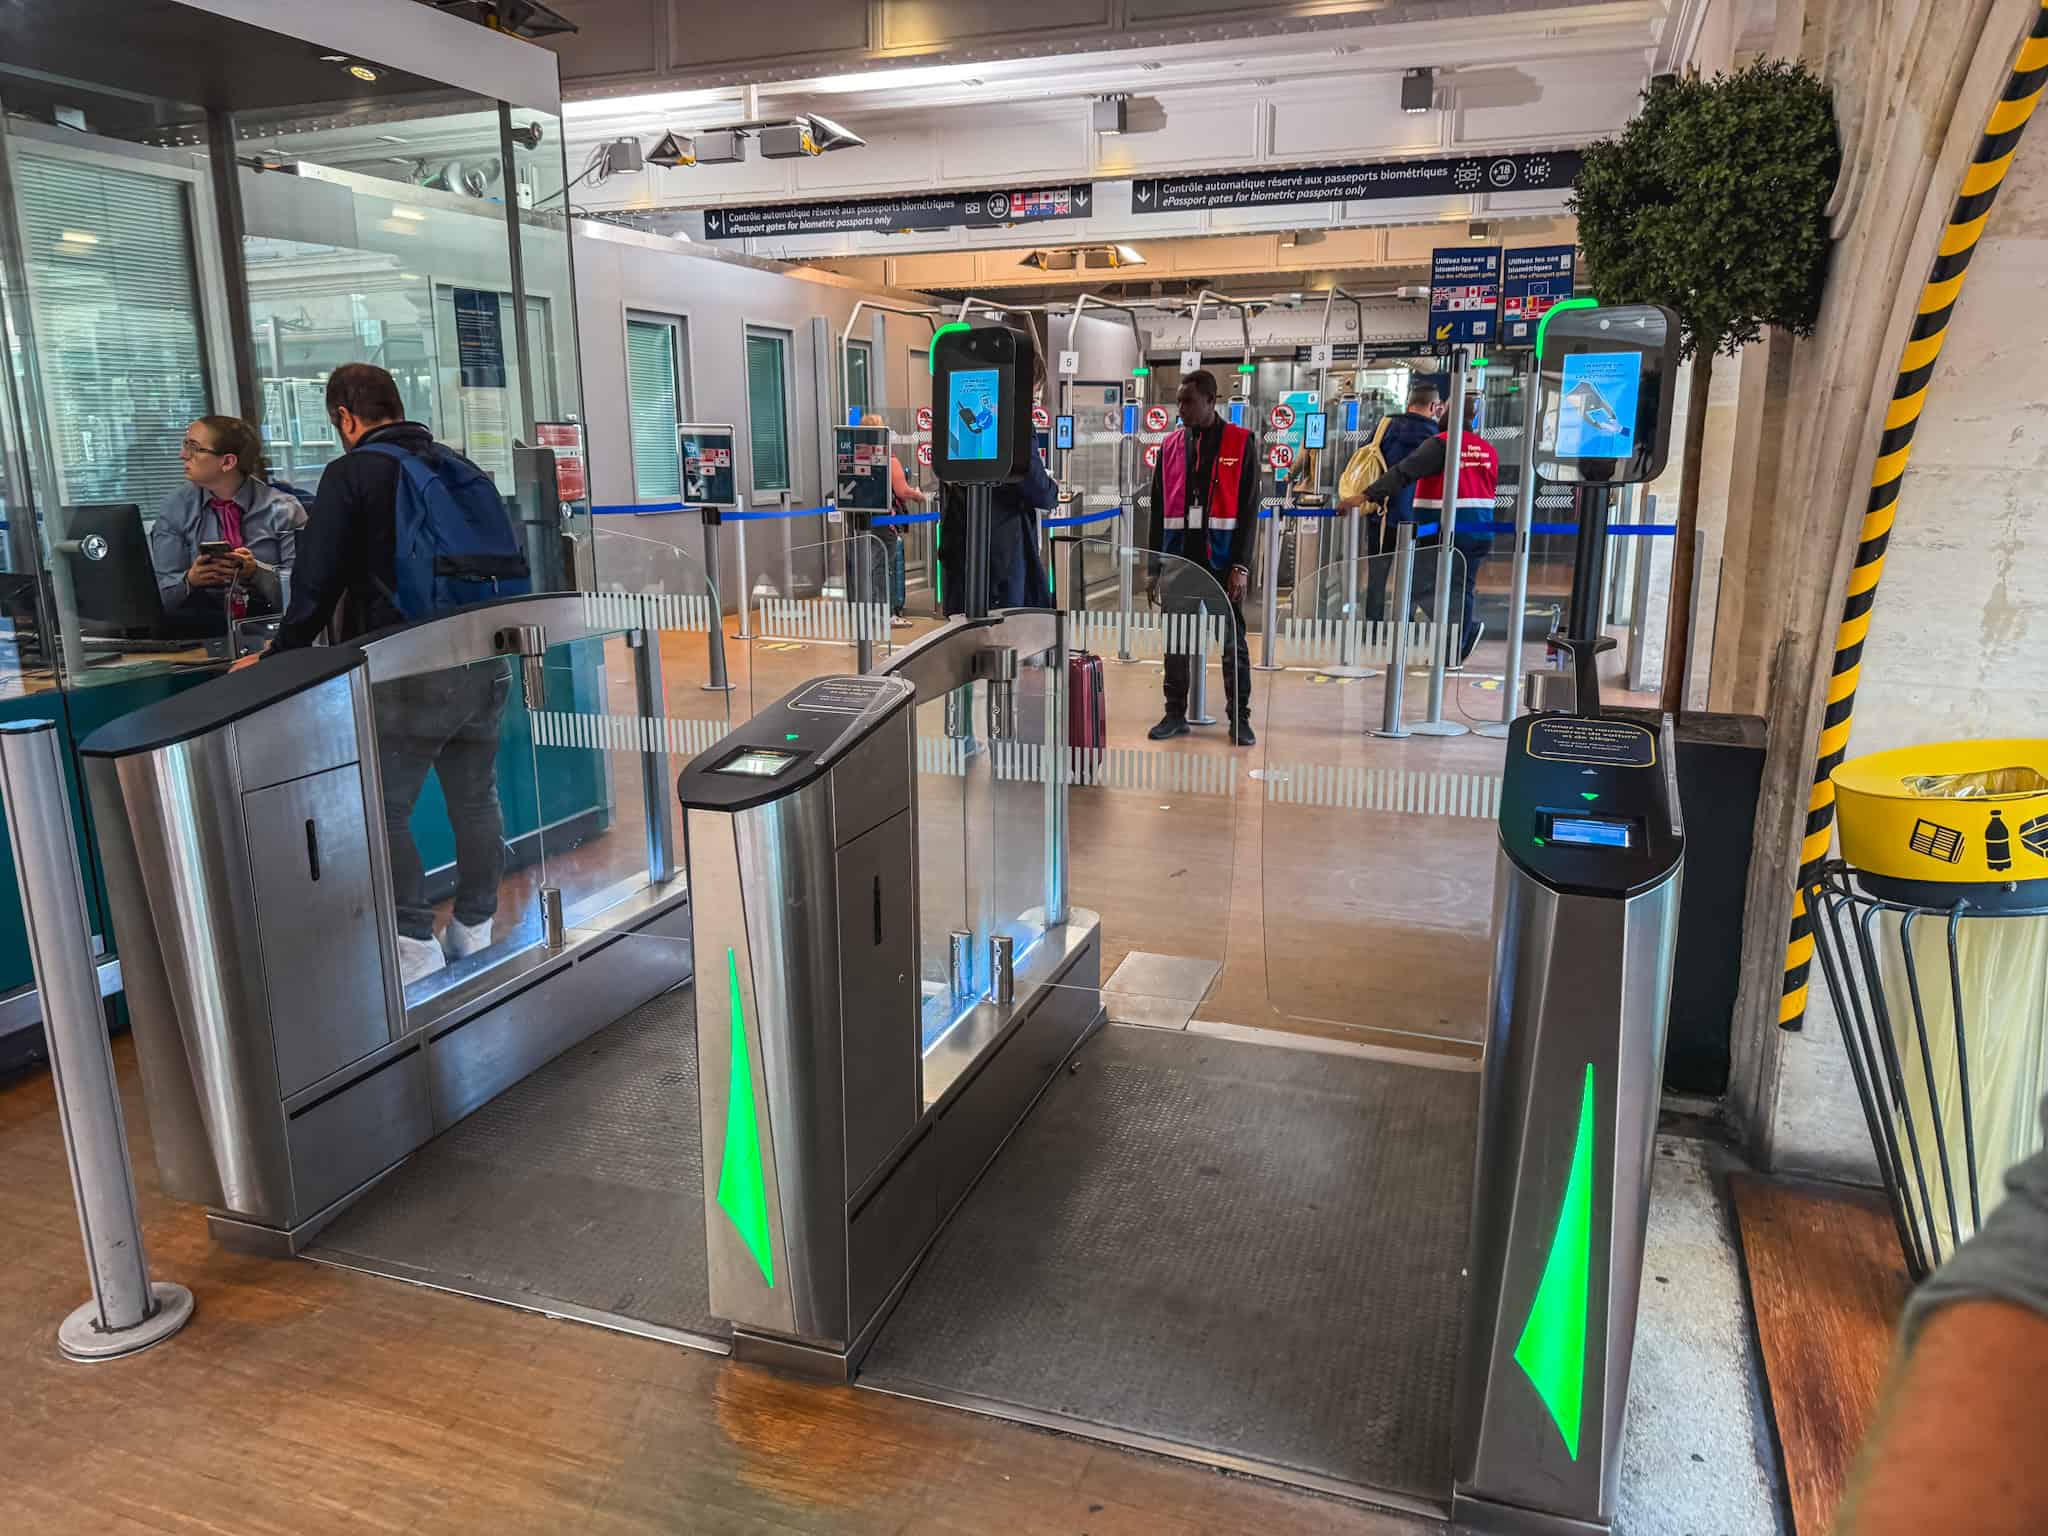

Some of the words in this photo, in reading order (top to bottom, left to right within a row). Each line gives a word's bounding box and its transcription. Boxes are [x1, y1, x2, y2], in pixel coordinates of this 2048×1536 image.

[1529, 165, 1545, 176] UE
[1163, 182, 1204, 194] Contrôle
[1205, 179, 1265, 191] automatique
[1268, 175, 1302, 187] réservé
[1305, 175, 1321, 185] aux
[1324, 172, 1378, 185] passeports
[1381, 167, 1448, 180] biométriques
[1163, 195, 1206, 208] ePassport
[1208, 194, 1233, 206] gates
[1235, 191, 1249, 202] for
[1250, 189, 1295, 201] biometric
[1297, 186, 1342, 200] passports
[1345, 185, 1367, 197] only
[728, 211, 761, 222] Contrôle
[763, 209, 810, 221] automatique
[812, 205, 839, 217] réservé
[841, 206, 856, 215] aux
[857, 202, 899, 215] passeports
[902, 199, 955, 212] biométriques
[729, 222, 765, 234] ePassport
[766, 221, 786, 233] gates
[787, 219, 798, 230] for
[800, 217, 834, 229] biometric
[836, 216, 873, 229] passports
[874, 215, 891, 227] only
[1066, 358, 1072, 367] 5
[1187, 358, 1193, 367] 4
[1318, 352, 1325, 361] 3
[840, 441, 851, 449] UK
[1271, 448, 1289, 464] -18
